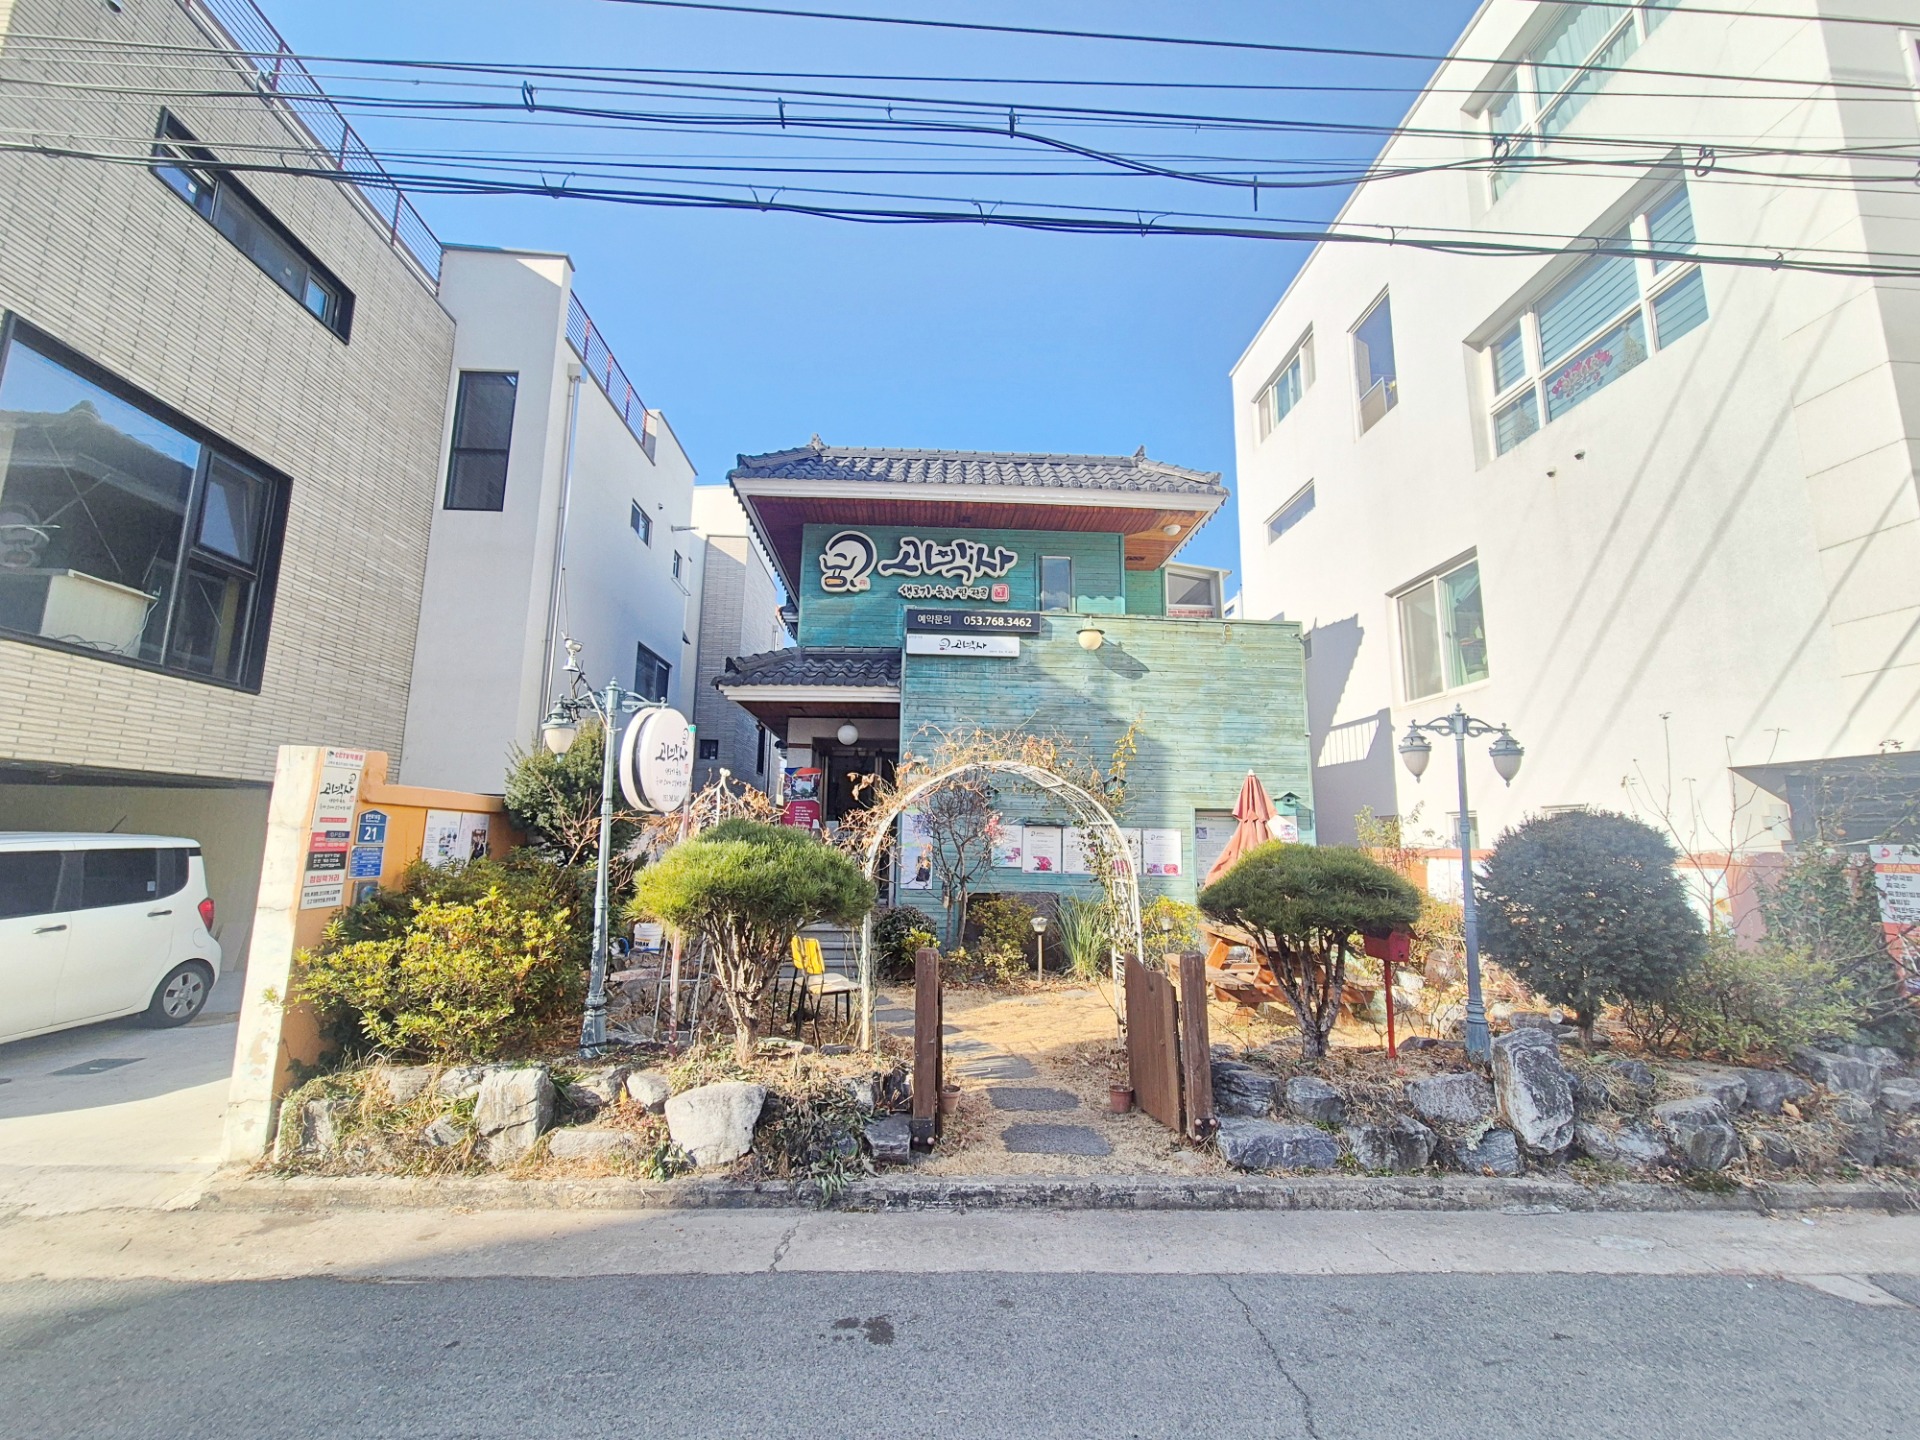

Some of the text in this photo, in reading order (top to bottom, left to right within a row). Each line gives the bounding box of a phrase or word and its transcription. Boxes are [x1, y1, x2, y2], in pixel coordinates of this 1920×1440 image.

[878, 537, 1018, 585] 고박사
[917, 614, 1032, 628] 예약문의 053.768.3462
[950, 639, 988, 652] 고박사
[655, 742, 689, 766] 고박사
[319, 782, 355, 798] 고박사
[363, 826, 378, 841] 21
